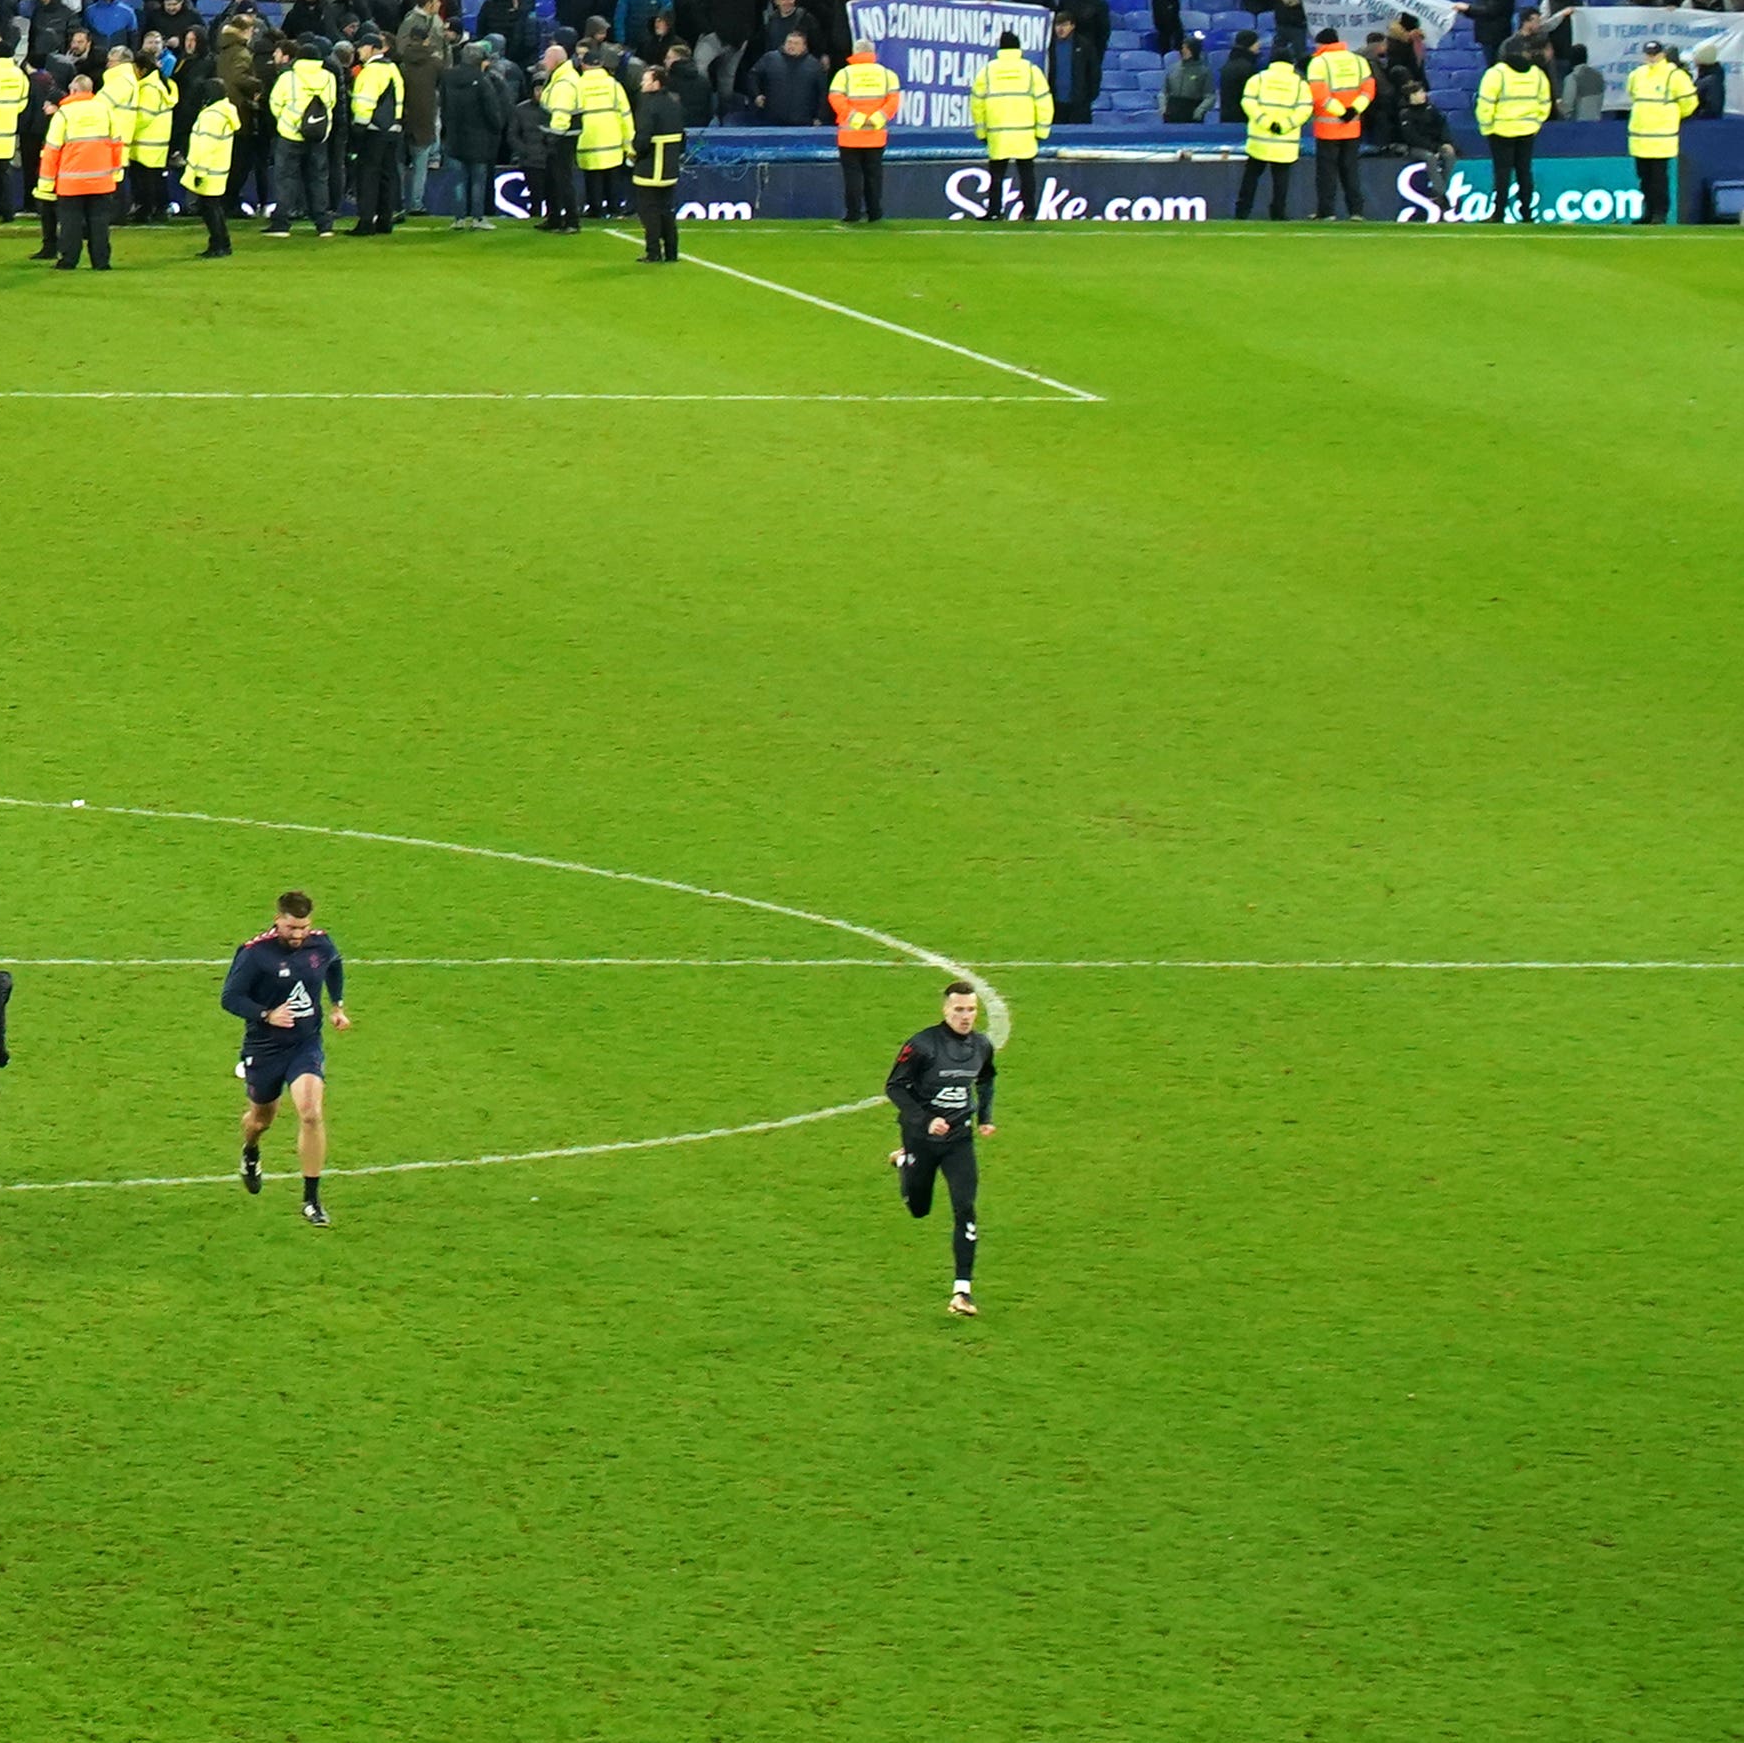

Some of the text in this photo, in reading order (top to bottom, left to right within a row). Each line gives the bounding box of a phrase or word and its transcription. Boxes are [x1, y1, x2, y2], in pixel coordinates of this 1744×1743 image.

[856, 2, 1047, 52] NO COMMUNICATION
[907, 47, 935, 86] NO
[896, 89, 974, 128] NO VISI
